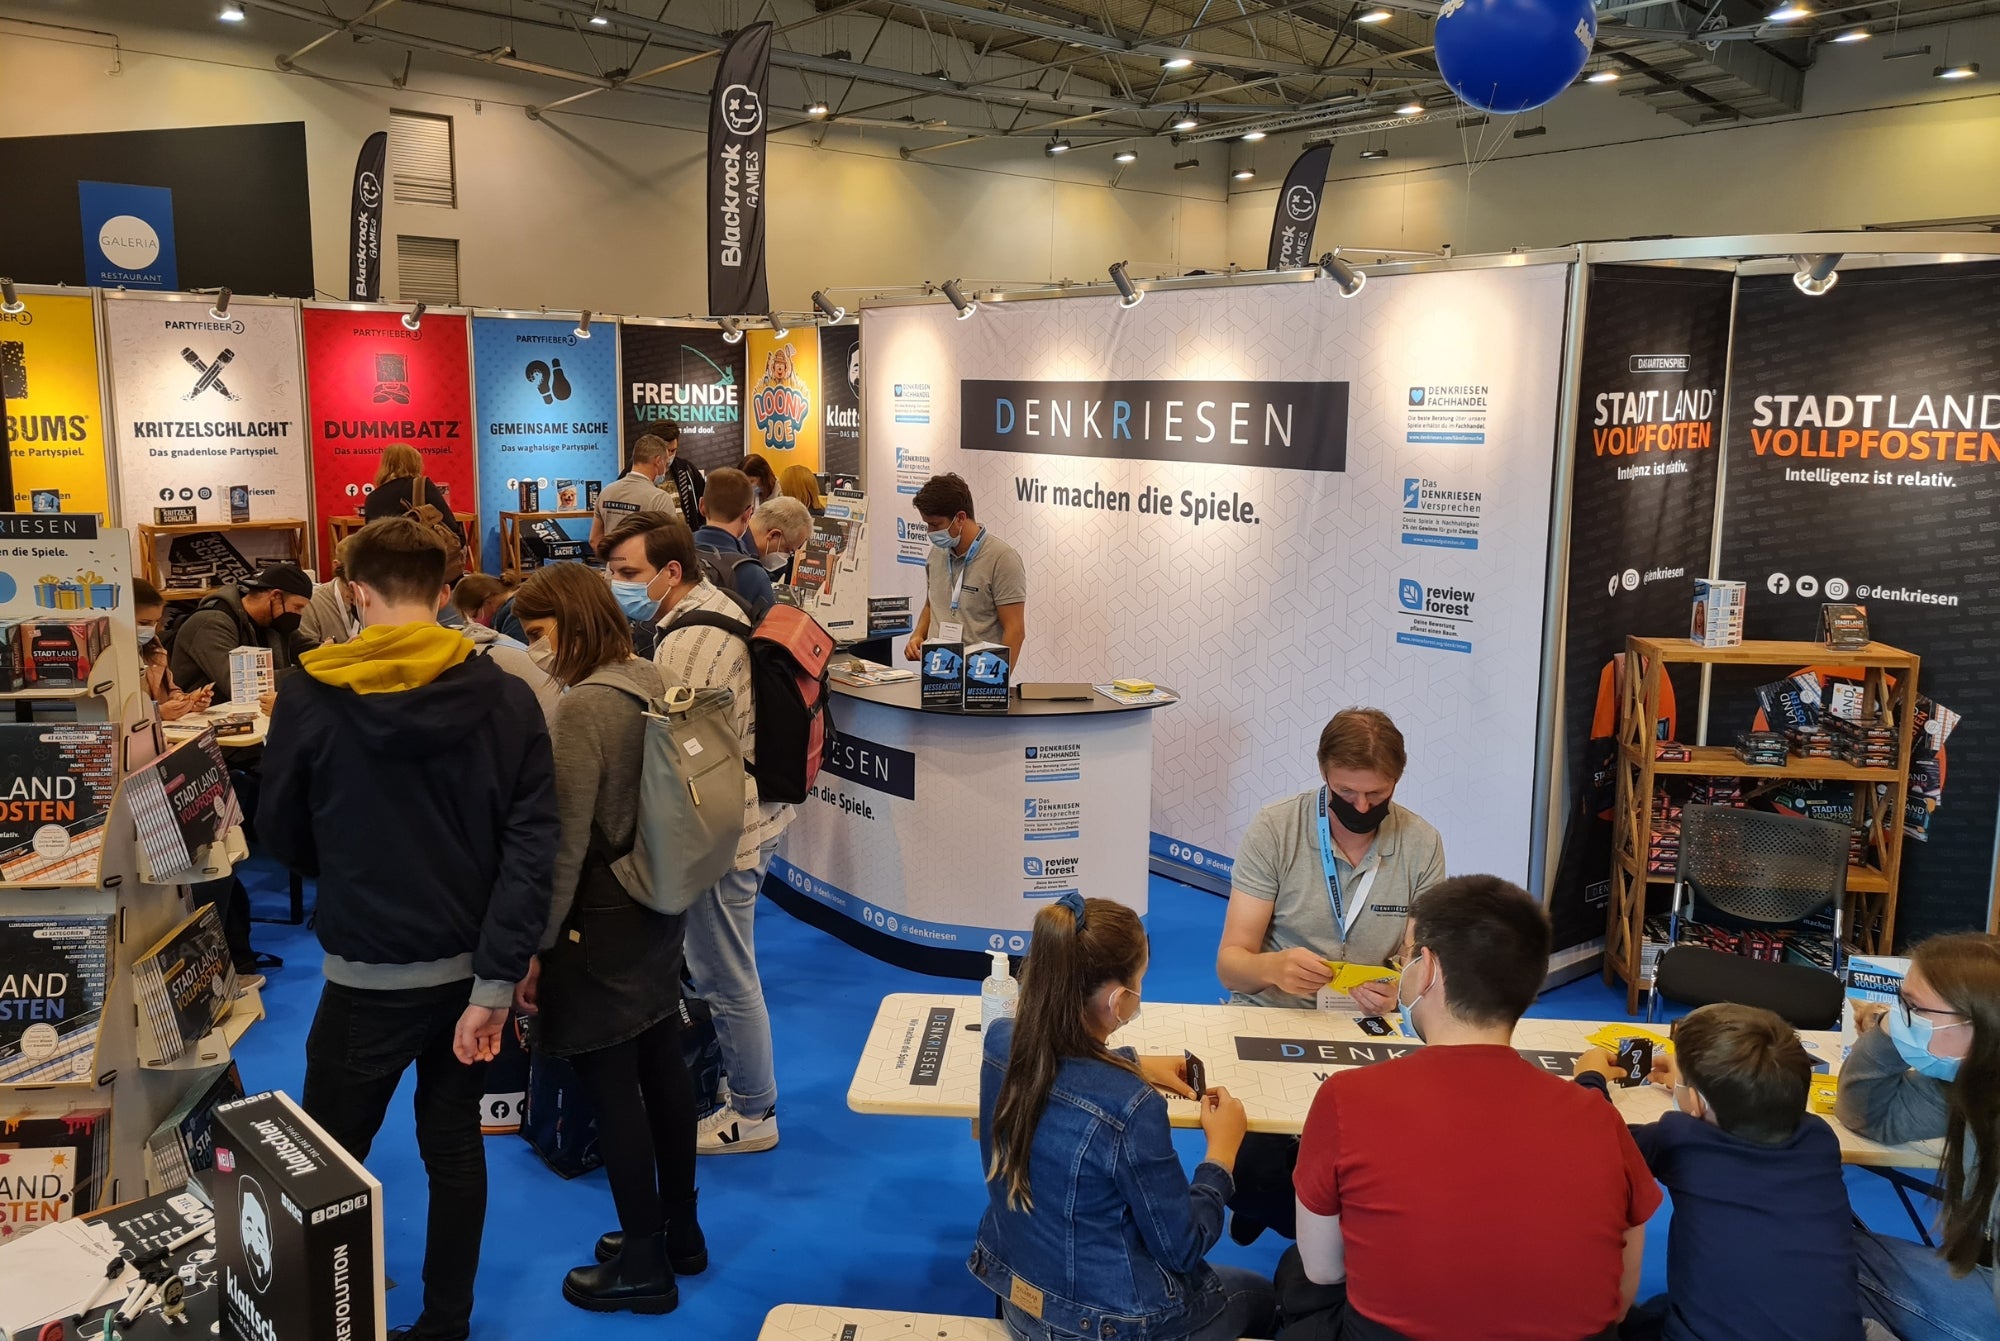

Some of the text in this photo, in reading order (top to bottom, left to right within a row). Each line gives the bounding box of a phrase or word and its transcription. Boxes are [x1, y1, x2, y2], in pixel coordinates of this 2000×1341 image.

[746, 150, 759, 208] GAMES
[721, 143, 741, 267] Blackrock
[101, 235, 157, 249] GALERIA
[369, 218, 377, 259] GAMES
[356, 211, 368, 297] Blackrock
[101, 272, 162, 282] RESTAURANT
[165, 321, 232, 332] PARTYFIEBER
[353, 328, 411, 339] PARTYFIEBER
[516, 335, 567, 344] PARTYFIEBER
[632, 382, 738, 405] FREUNDE
[1428, 386, 1488, 395] DENKRIESEN
[756, 388, 808, 422] LOONY
[1427, 397, 1487, 406] FACHHANDEL
[1594, 390, 1659, 426] STADT
[634, 405, 738, 422] VERSENKEN
[1752, 395, 1882, 428] STADT
[490, 422, 608, 435] GEMEINSAME SACHE
[995, 398, 1294, 447] DENKRIESEN
[134, 421, 289, 439] KRITZELSCHLACHT
[324, 421, 459, 439] DUMMBATZ
[683, 426, 715, 434] sind doof.
[767, 420, 794, 443] JOE
[334, 446, 347, 455] Das
[501, 443, 599, 454] Das waghalsige Partyspiel.
[1750, 428, 2000, 462] VOLLPFOSTEN
[29, 447, 84, 458] Partyspiel.
[149, 447, 279, 458] Das gnadenlose Partyspiel.
[1654, 461, 1665, 475] ist
[1422, 479, 1437, 487] Das
[1785, 467, 1957, 488] Intelligenz ist relativ.
[1015, 476, 1260, 525] Wir machen die Spiele.
[1421, 490, 1481, 501] DENKRIESEN
[1421, 501, 1480, 512] Versprechen
[163, 515, 194, 523] SCHLACHT
[907, 531, 927, 541] forest
[12, 547, 68, 558] die Spiele.
[1427, 587, 1475, 602] review
[1856, 584, 1958, 606] @denkriesen
[1426, 599, 1469, 616] forest
[931, 653, 955, 673] 5 4
[976, 658, 1000, 677] 5 4
[924, 683, 961, 691] MESSEAKTION
[1780, 692, 1797, 724] LAND
[1040, 744, 1080, 752] DENKRIESEN
[1040, 751, 1080, 759] FACHHANDEL
[174, 767, 219, 811] STADT LAND
[821, 786, 875, 820] die Spiele.
[1039, 803, 1080, 811] DENKRIESEN
[1811, 805, 1838, 813] STADT
[1039, 810, 1080, 818] Versprechen
[1045, 857, 1079, 866] review
[1045, 866, 1075, 875] forest
[1803, 917, 1831, 930] machen
[902, 924, 957, 942] @denkriesen
[172, 945, 219, 999] STADT LAND
[1854, 972, 1881, 983] STADT
[176, 958, 223, 1011] VOLLPFOSTEN
[918, 1014, 948, 1077] DENKRIESEN
[1631, 1050, 1642, 1064] 7
[177, 1196, 193, 1210] ZIEL
[333, 1244, 350, 1341] REVOLUTION
